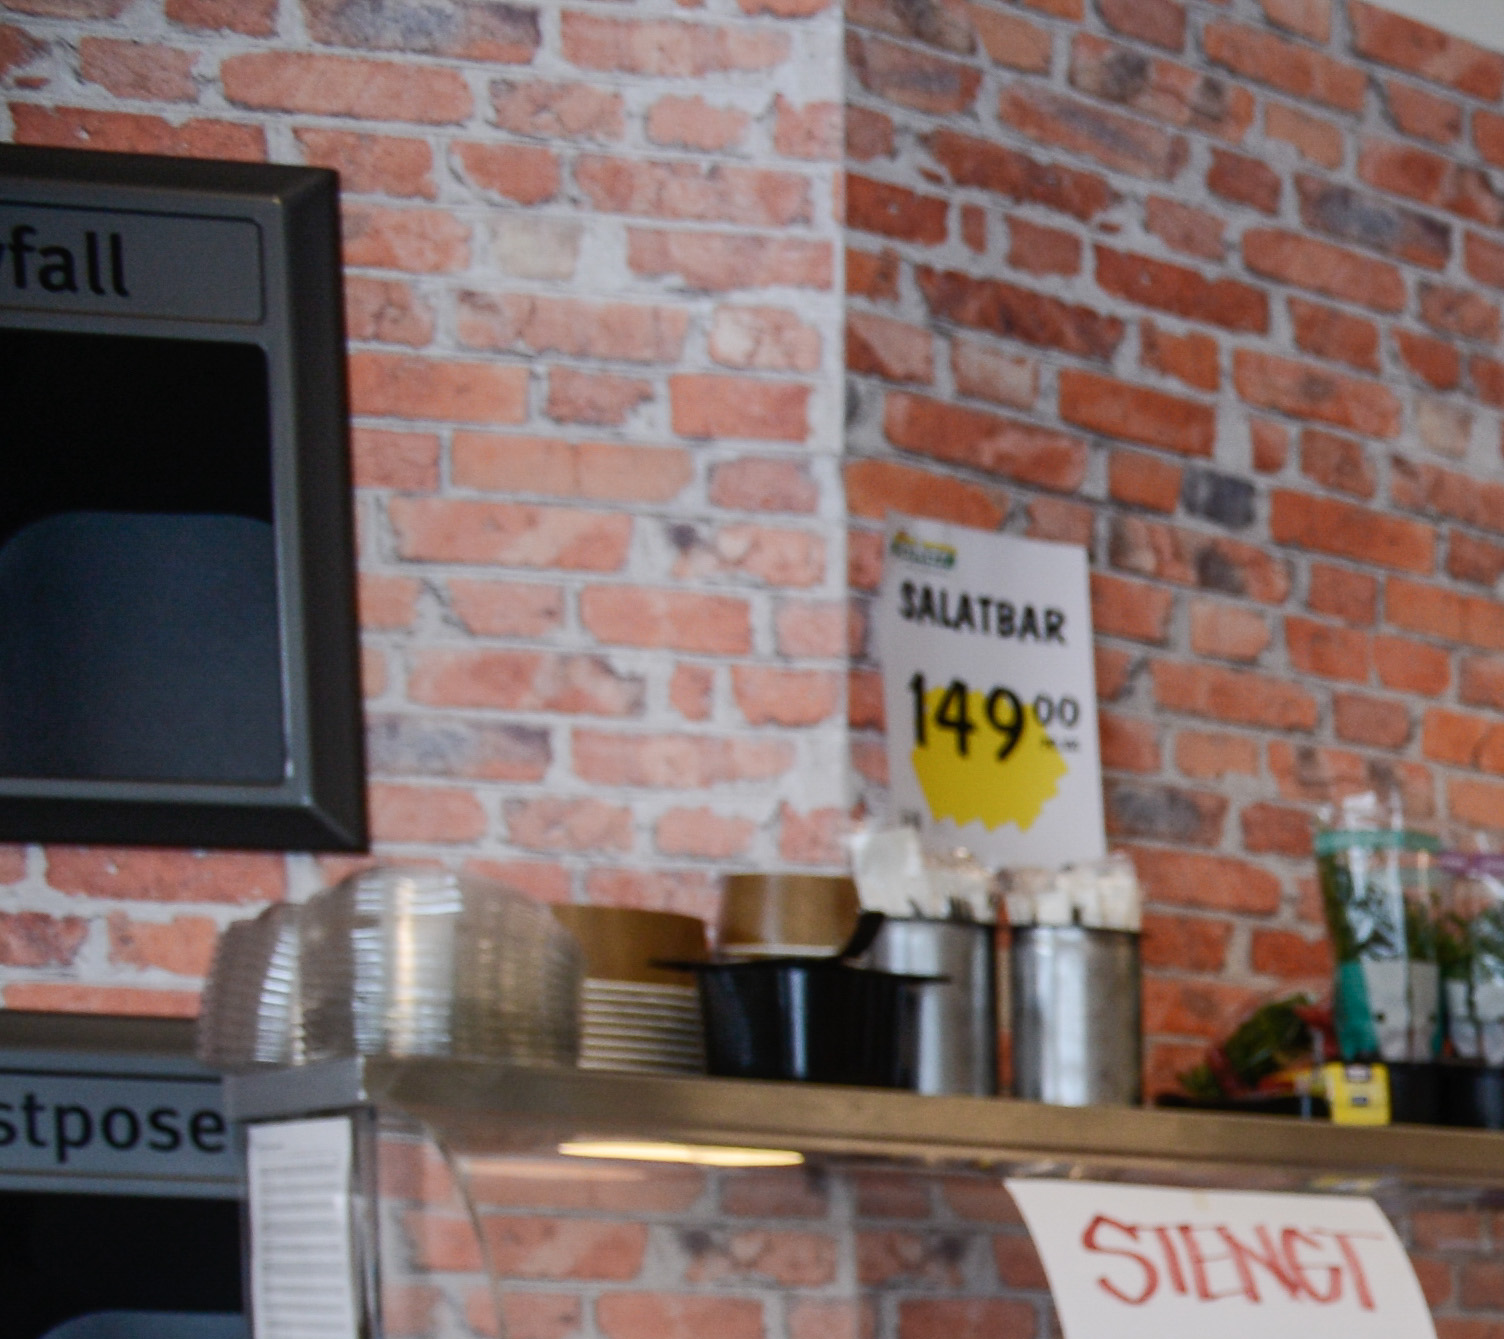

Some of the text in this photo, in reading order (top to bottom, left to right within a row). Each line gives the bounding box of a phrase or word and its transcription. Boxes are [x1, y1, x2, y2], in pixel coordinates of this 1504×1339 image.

[0, 225, 129, 297] fall
[899, 580, 1067, 645] SALATBAR
[909, 671, 1026, 762] 149
[1081, 1213, 1384, 1312] STENGT
